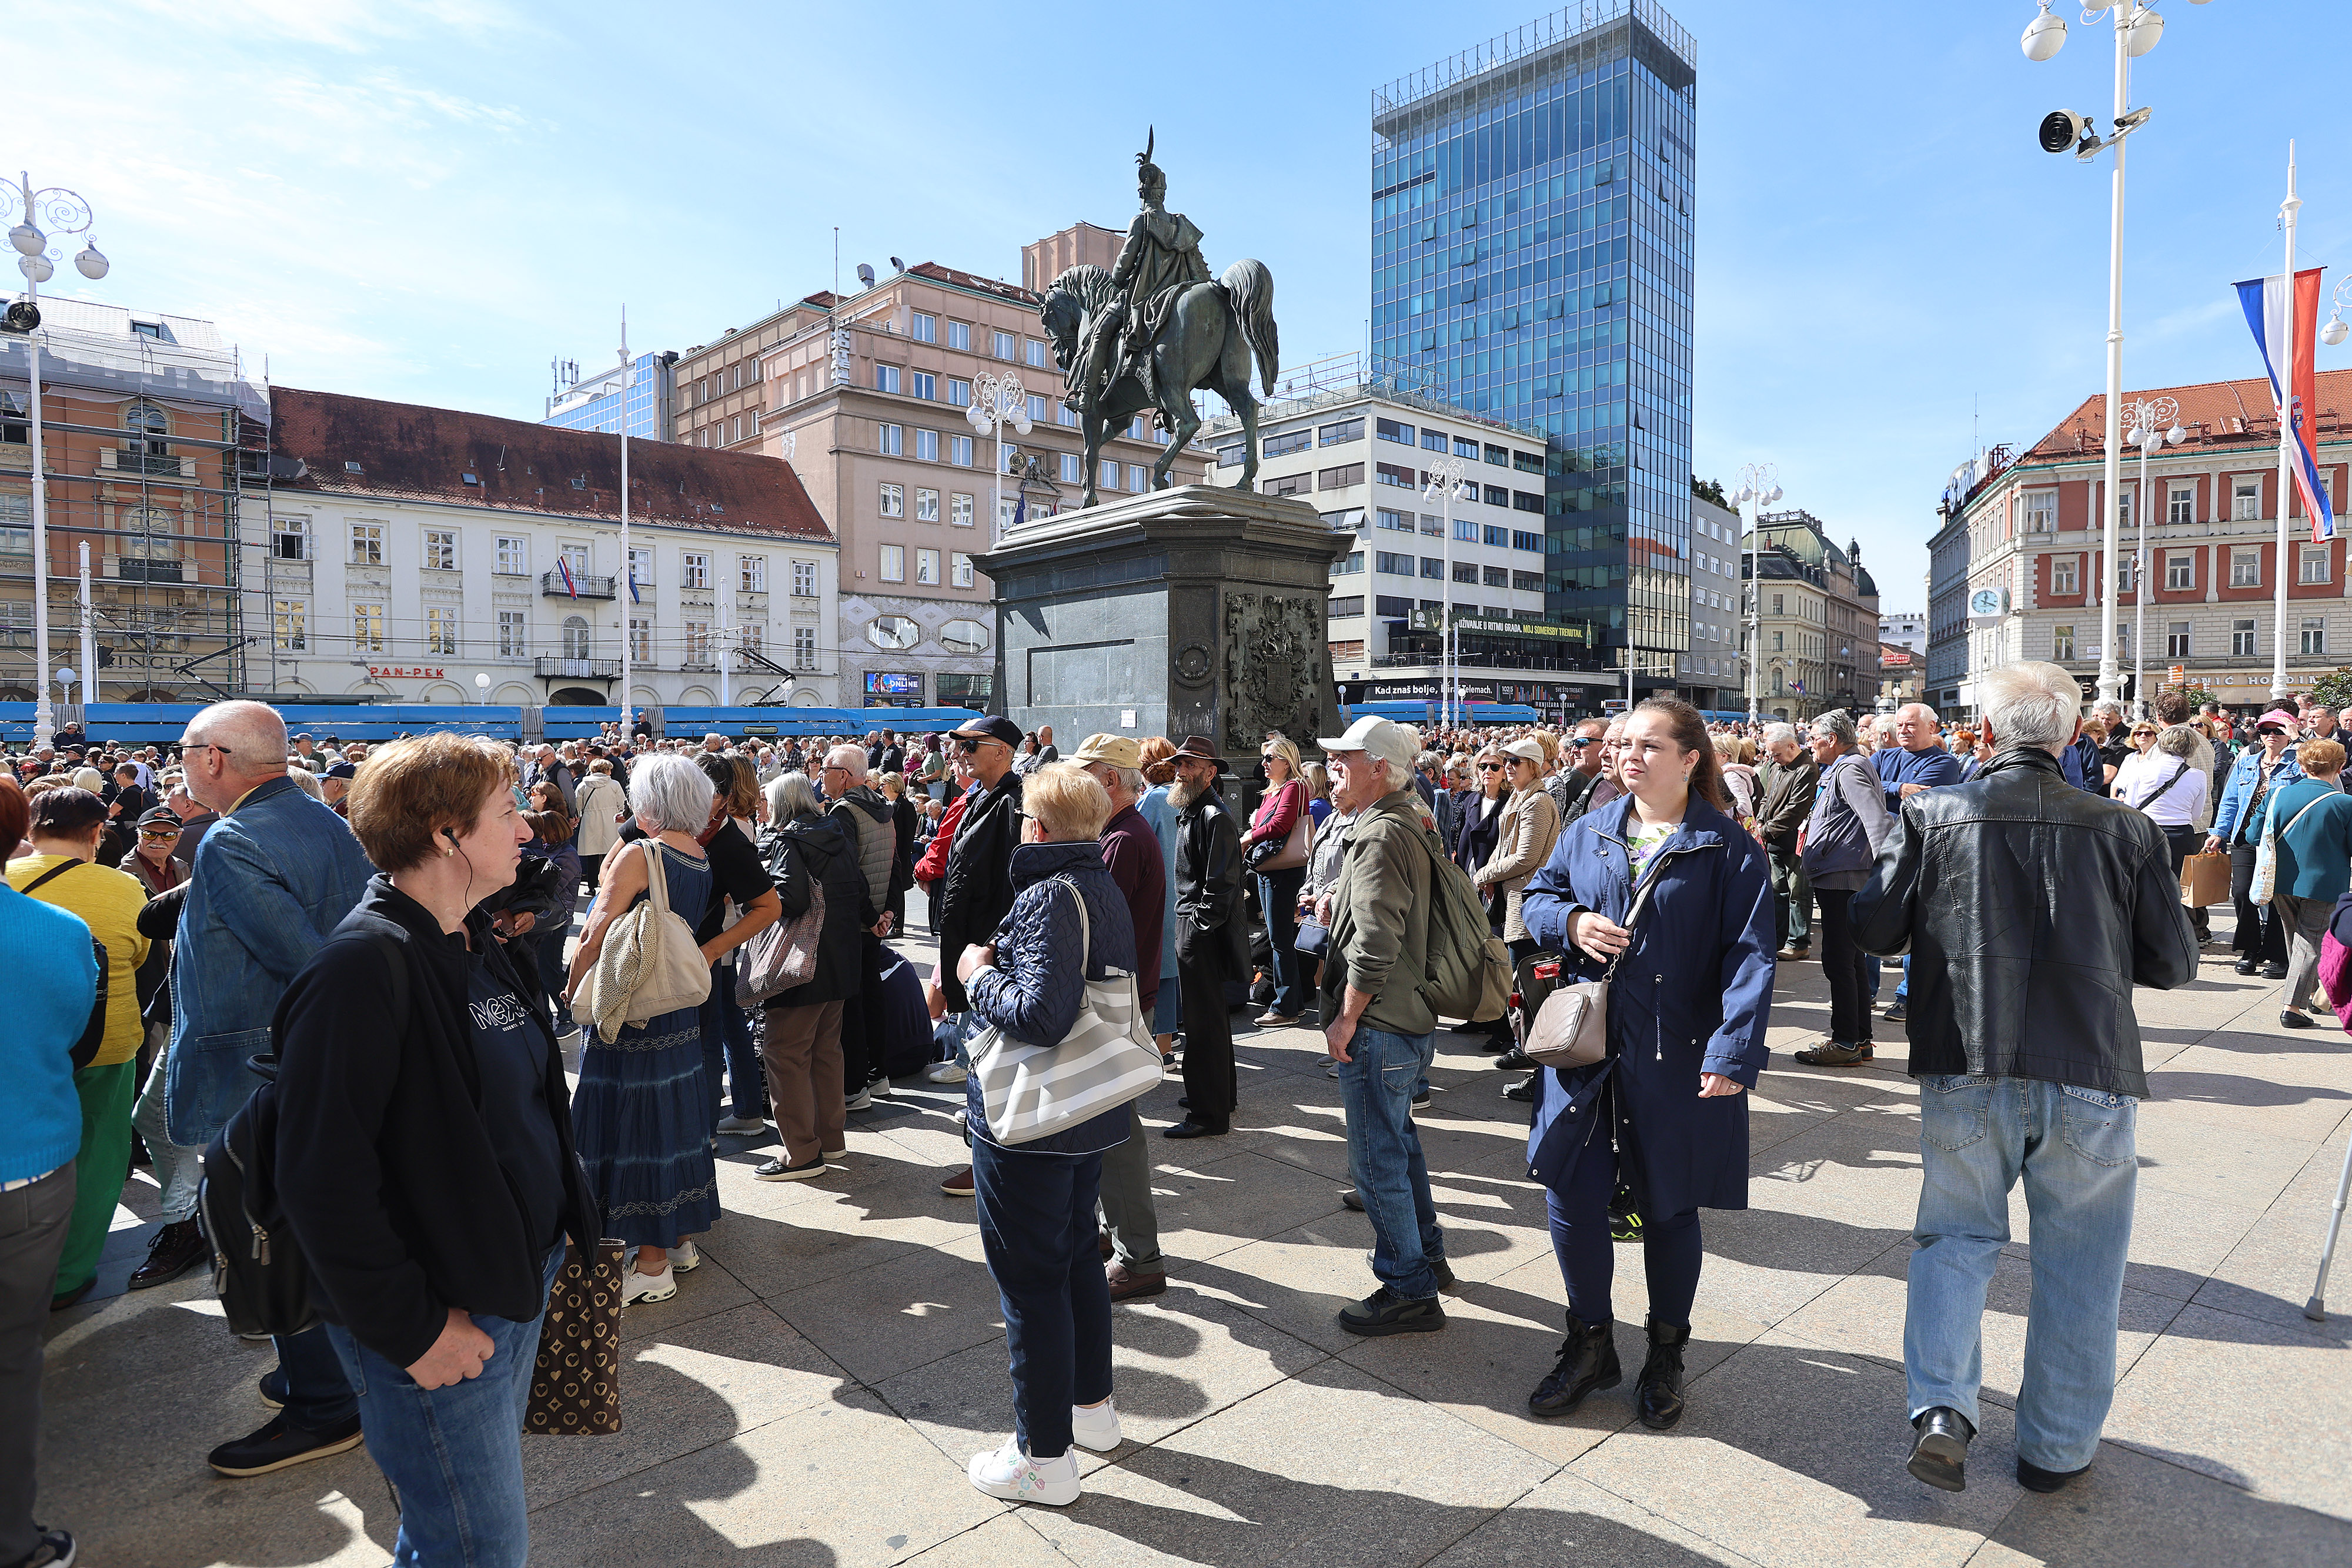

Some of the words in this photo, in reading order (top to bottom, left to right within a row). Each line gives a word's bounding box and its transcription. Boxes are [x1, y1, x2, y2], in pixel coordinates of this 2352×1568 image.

[837, 329, 850, 380] HOTEL
[1459, 617, 1483, 629] UŽIVANJE
[1488, 621, 1504, 631] RITMU
[1504, 623, 1522, 633] GRADA.
[1523, 624, 1534, 634] MOJ
[1534, 625, 1558, 636] SOMERSBY
[1559, 627, 1583, 638] TRENUTAK.
[108, 656, 196, 670] INGER
[370, 667, 444, 677] PAN-PEK
[1375, 685, 1391, 694] Kad
[1392, 685, 1411, 694] znaš
[1412, 684, 1438, 695] bolje,
[1538, 700, 1559, 708] KNJIŽARA
[502, 1020, 525, 1032] ESSENTILS
